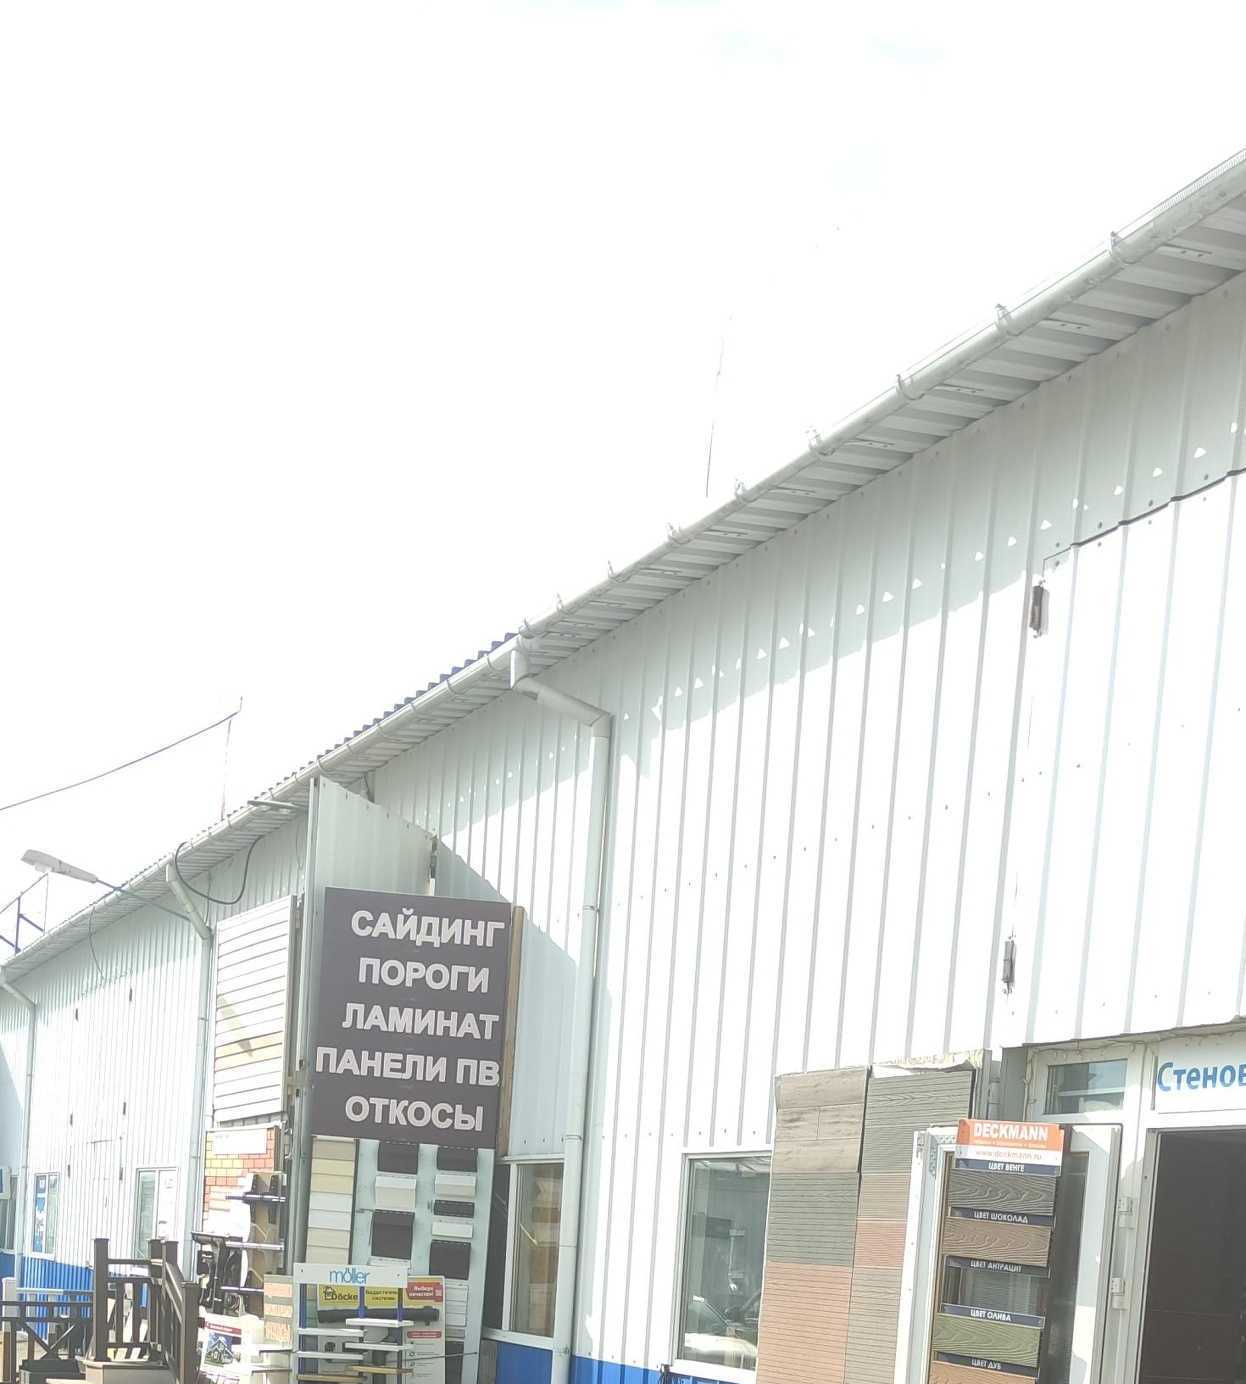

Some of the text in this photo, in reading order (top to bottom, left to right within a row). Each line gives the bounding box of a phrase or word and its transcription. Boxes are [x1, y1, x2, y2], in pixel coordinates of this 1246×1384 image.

[351, 908, 505, 948] САЙДИНГ
[358, 957, 489, 993] ПОРОГИ
[342, 1002, 499, 1040] ЛАМИНАТ
[316, 1046, 447, 1082] ПАНЕЛИ
[345, 1095, 484, 1132] ОТКОСЫ
[974, 1123, 1049, 1141] DECKMANN
[988, 1162, 1025, 1172] ЦВЕТ ВЕНГЕ
[974, 1211, 1028, 1223] ЦВЕТ ШОКОЛАД
[970, 1260, 1022, 1272] ЦВЕТ АНТРАЦИТ
[329, 1267, 370, 1283] möller
[970, 1309, 1012, 1321] ЦВЕТ ОЛИВА
[971, 1359, 1002, 1370] ЦВЕТ ДУБ
